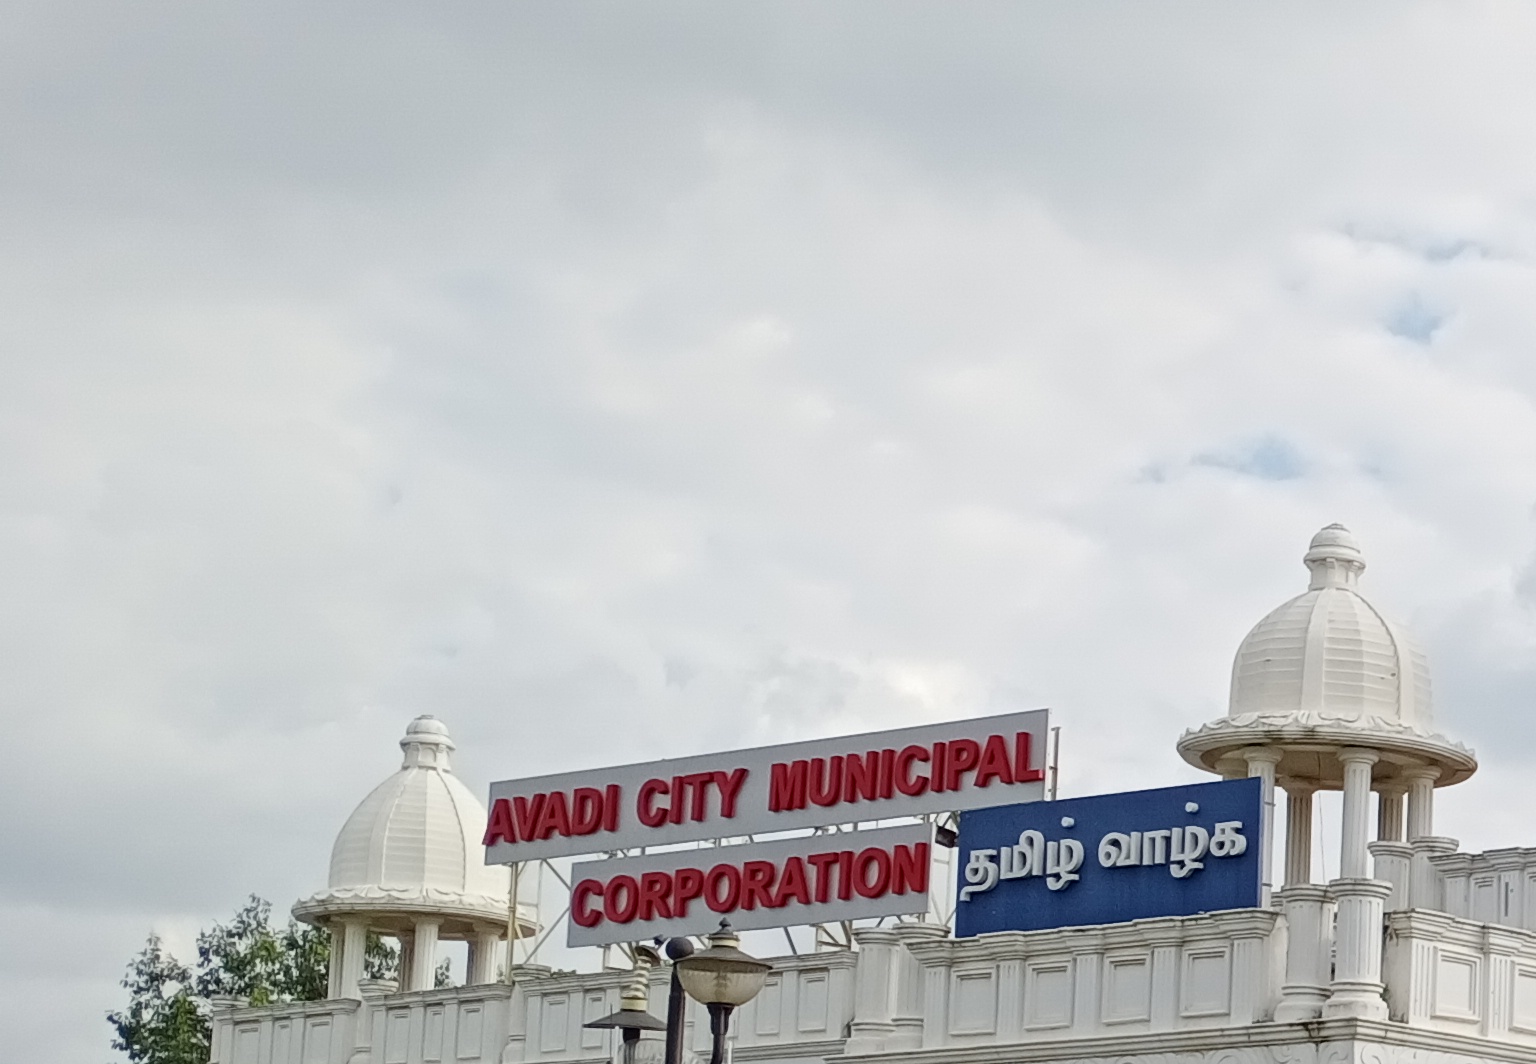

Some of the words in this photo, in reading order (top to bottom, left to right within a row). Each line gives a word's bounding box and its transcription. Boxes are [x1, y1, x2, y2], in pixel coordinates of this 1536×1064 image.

[482, 784, 620, 845] AVADI
[638, 769, 747, 828] CITY
[768, 731, 1045, 812] MUNICIPAL
[571, 842, 930, 928] CORPORATION
[959, 816, 1084, 901] தமிழ்
[1098, 801, 1247, 879] வாழ்க
